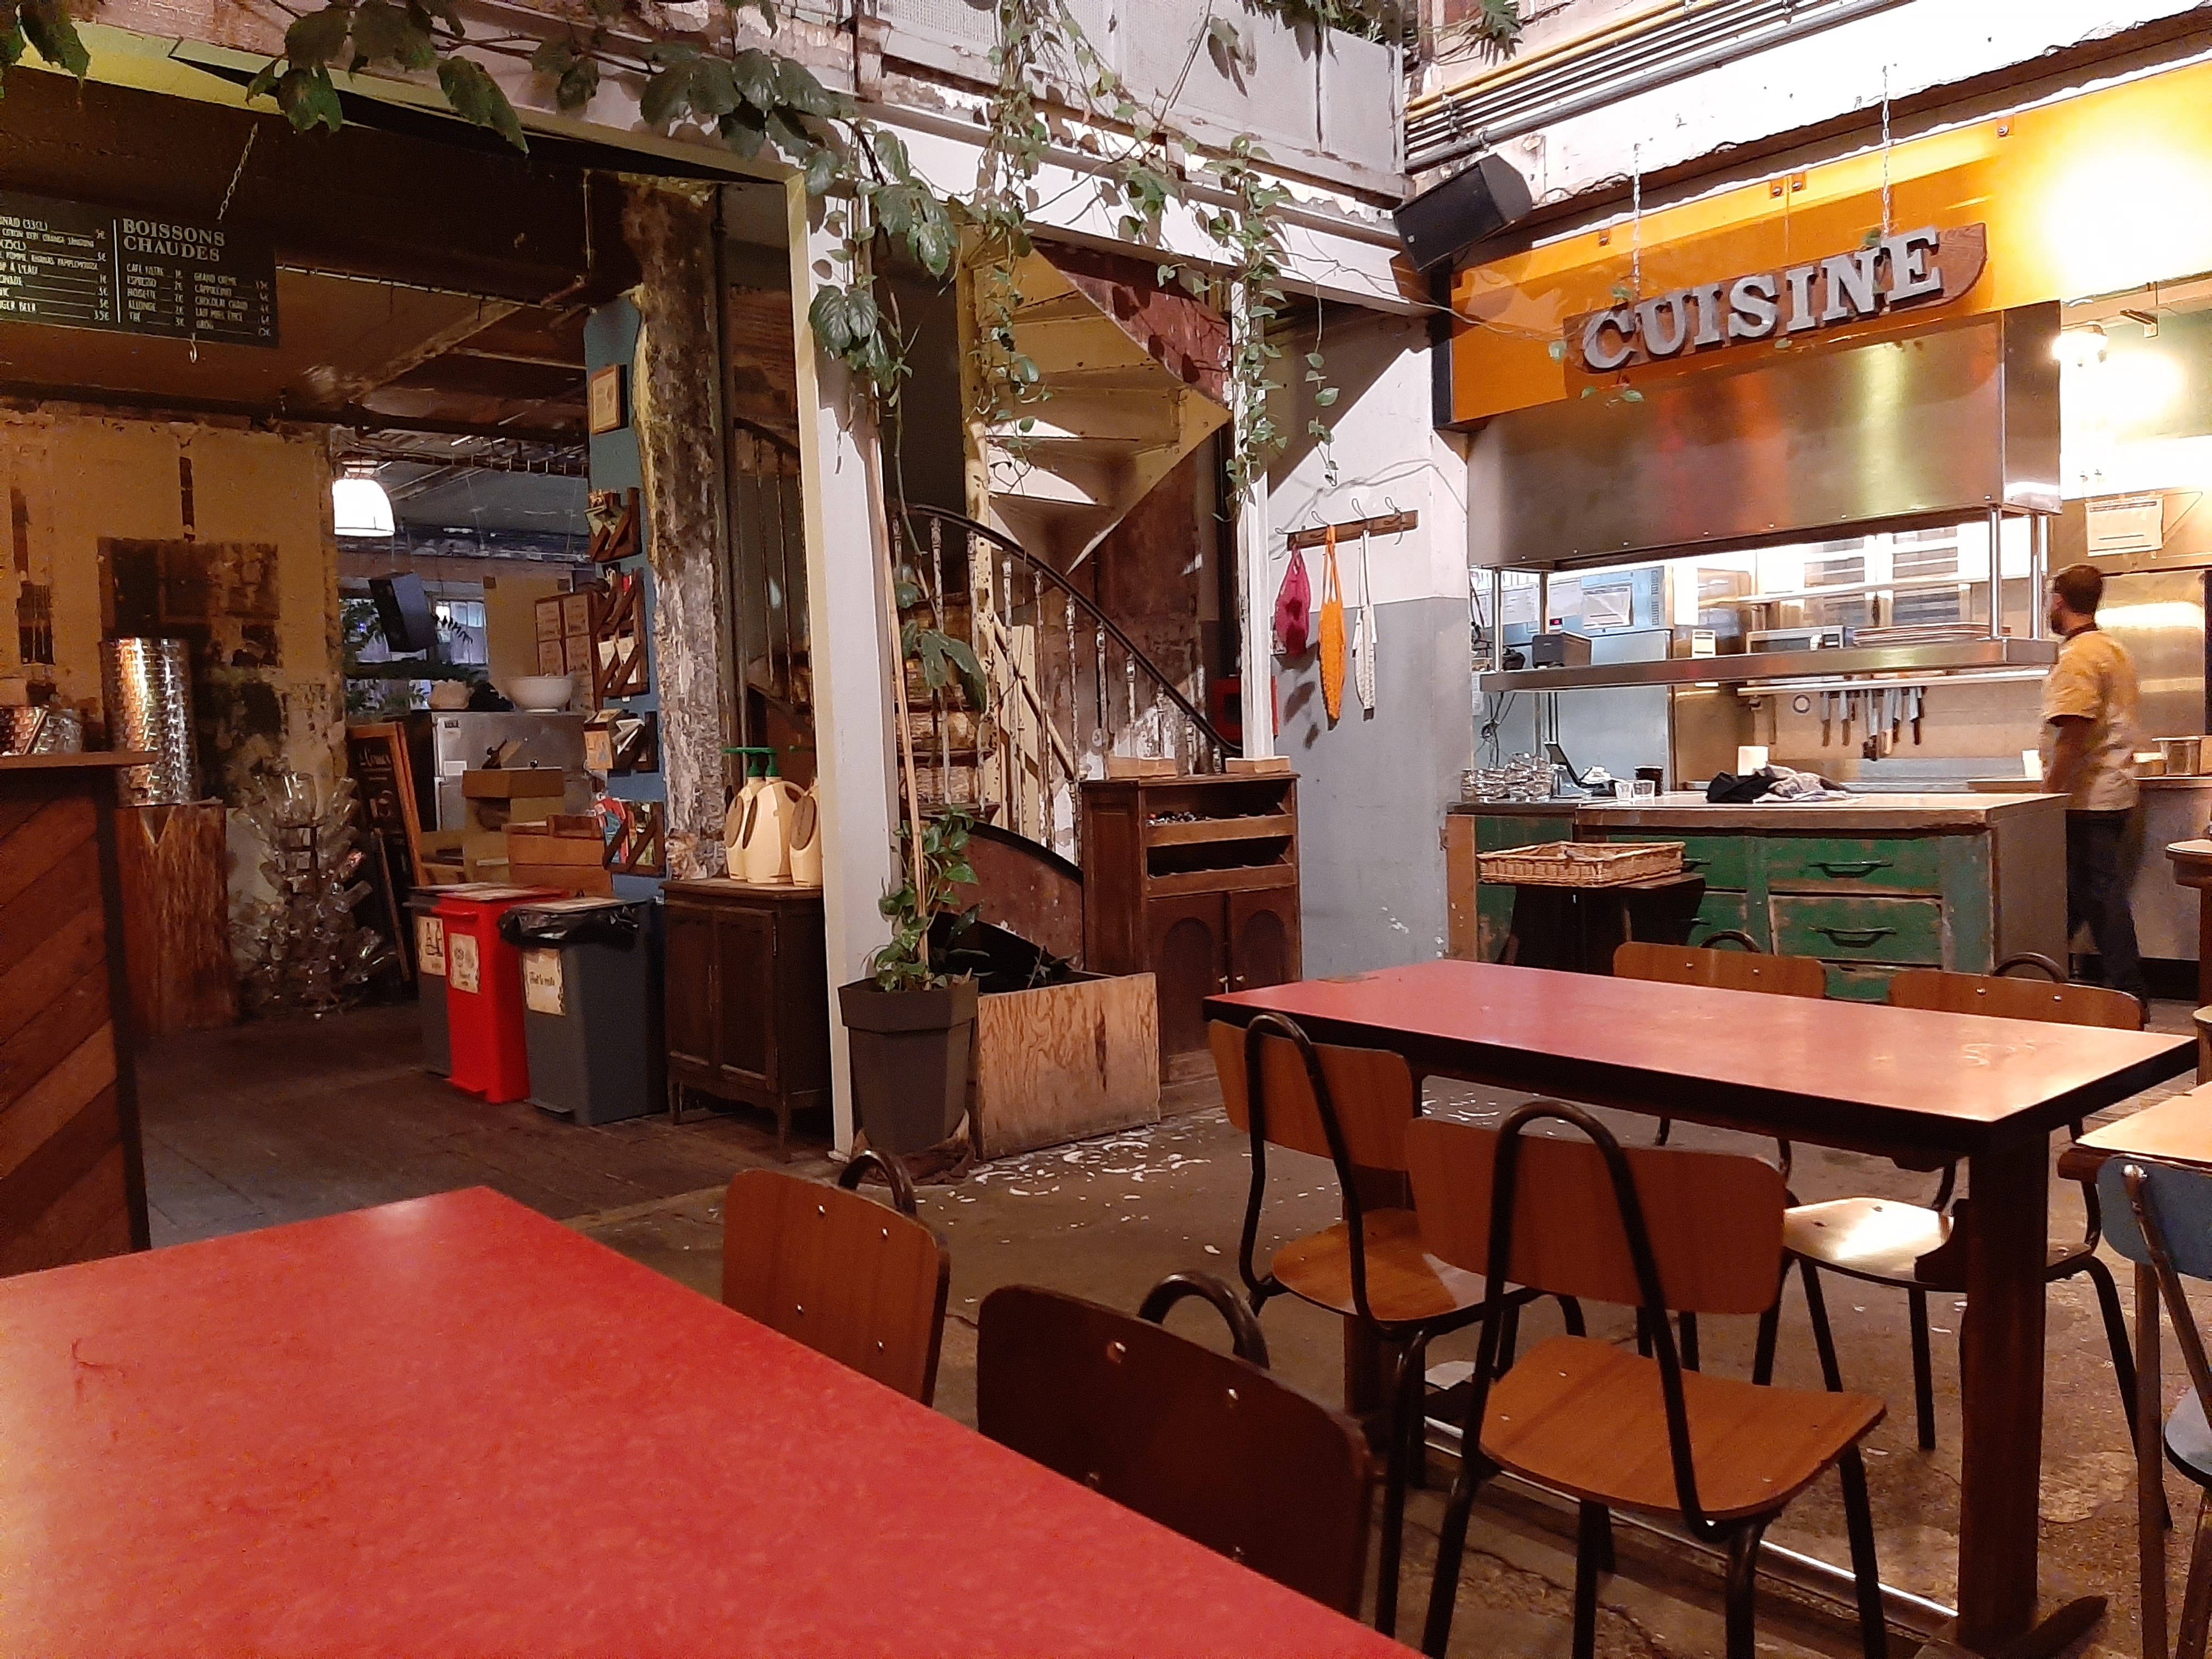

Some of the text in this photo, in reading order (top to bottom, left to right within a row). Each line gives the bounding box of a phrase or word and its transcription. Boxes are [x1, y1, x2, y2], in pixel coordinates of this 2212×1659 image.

[123, 218, 225, 246] BOISSONS
[123, 235, 220, 262] CHAUDES
[1582, 226, 1944, 370] CUISINE
